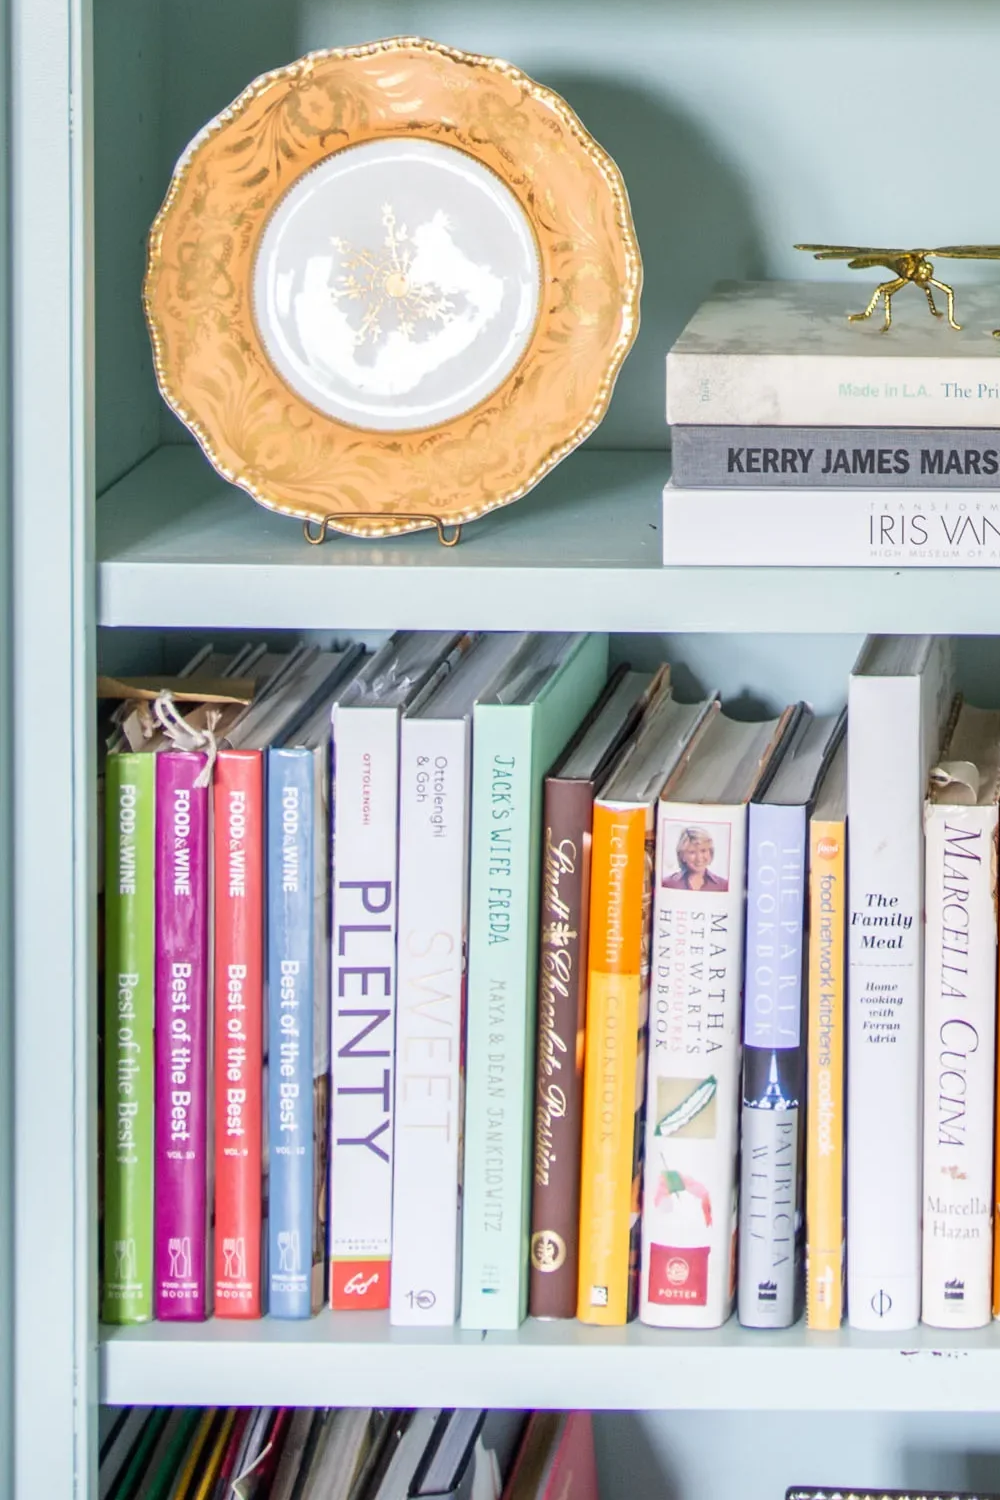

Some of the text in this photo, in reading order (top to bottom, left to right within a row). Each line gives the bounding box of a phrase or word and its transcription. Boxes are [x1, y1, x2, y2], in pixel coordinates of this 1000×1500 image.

[838, 382, 882, 398] Made
[886, 383, 898, 398] in
[941, 383, 973, 401] The
[727, 447, 813, 474] KERRY
[822, 448, 910, 474] JAMES
[870, 515, 929, 545] IRIS
[362, 753, 371, 825] OTTOLENGHI
[416, 756, 429, 802] & Goh
[430, 756, 446, 838] Ottolenghi
[487, 755, 515, 946] JACK'S WIFE FREDA
[605, 824, 629, 962] Le Bernardin
[851, 913, 913, 929] Family
[865, 894, 898, 907] The
[170, 789, 191, 1140] FOOD&WINE Best of the Best
[655, 909, 672, 1050] HANDBOOK
[860, 935, 903, 949] Meal
[336, 880, 391, 1163] PLENTY
[535, 828, 577, 1185] Lindt Chocolate Passion
[705, 914, 728, 1056] MARTHA
[817, 874, 836, 1155] food network kitchens cookbook
[938, 822, 982, 1146] MARCELLA CUCINA
[659, 1288, 697, 1299] POTTER
